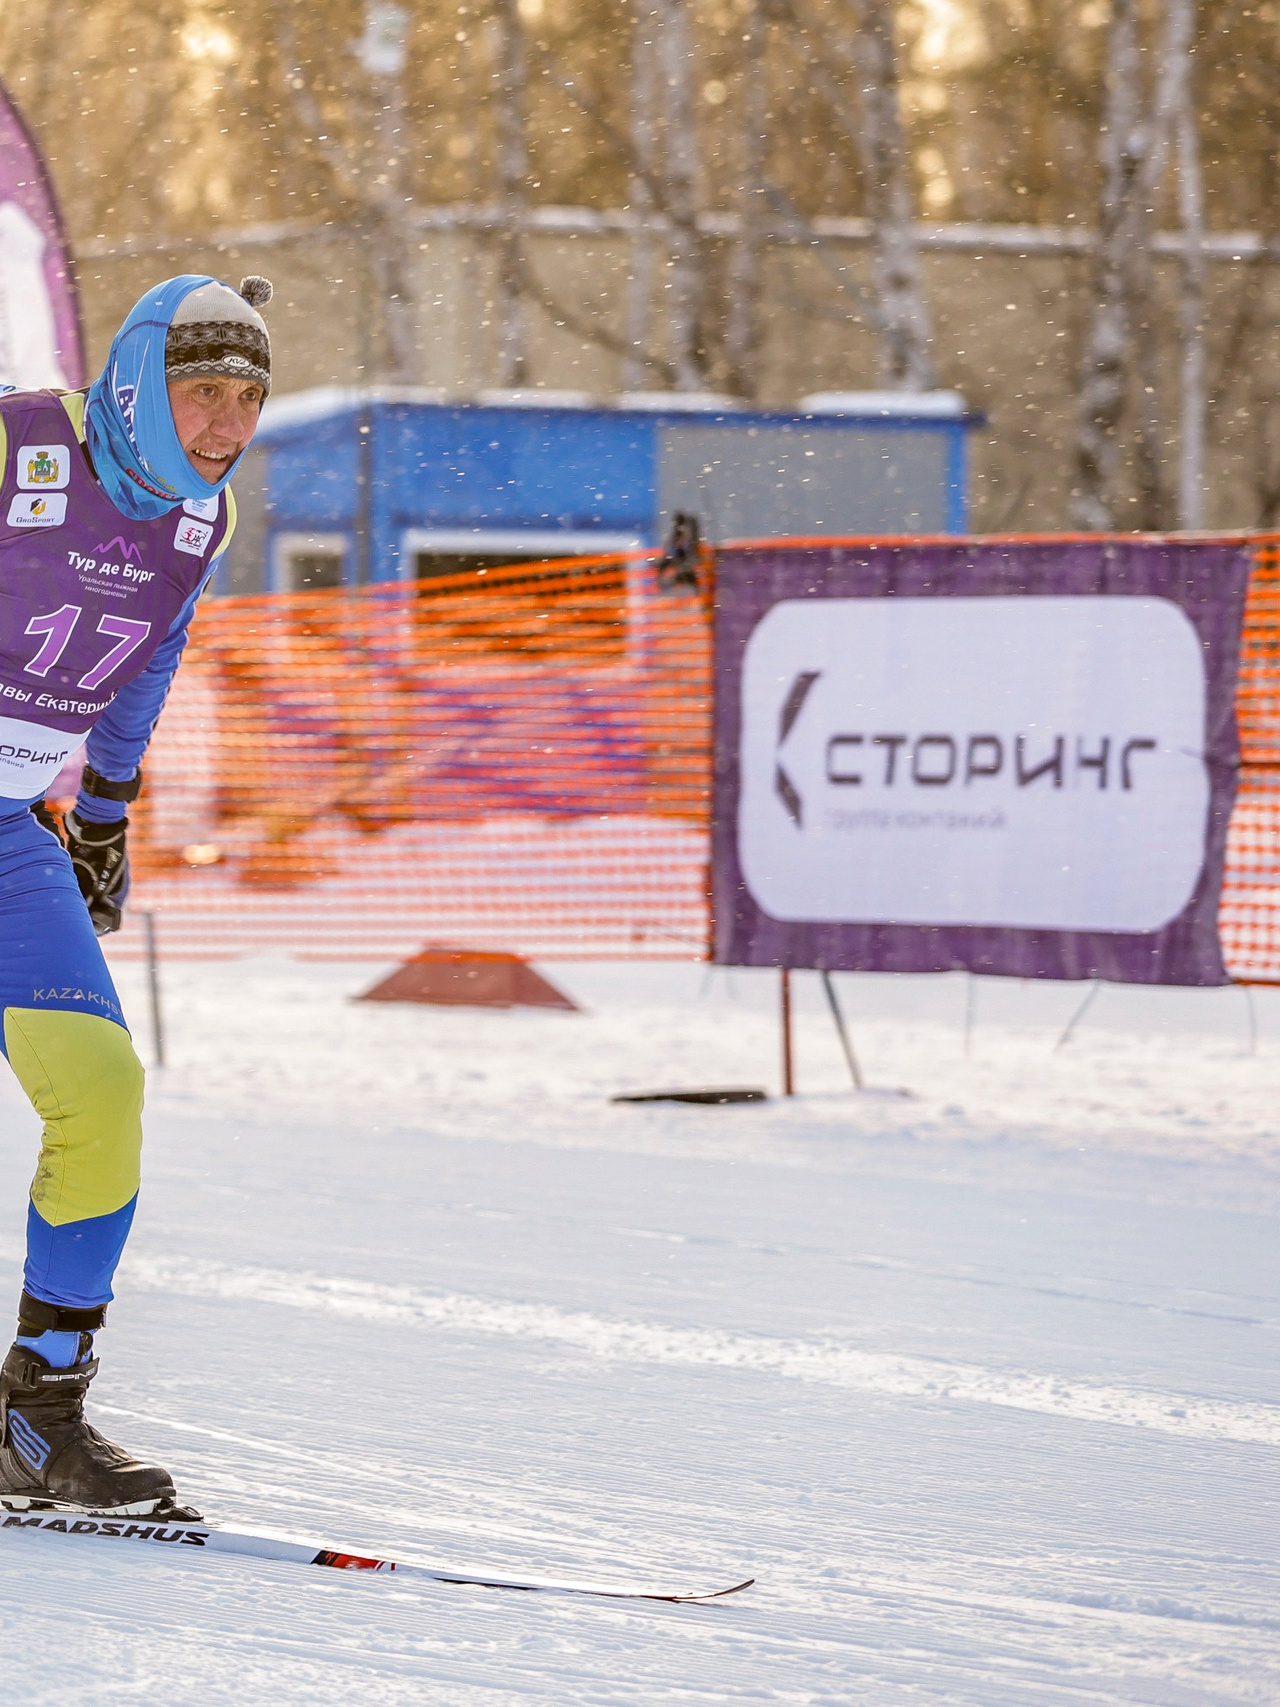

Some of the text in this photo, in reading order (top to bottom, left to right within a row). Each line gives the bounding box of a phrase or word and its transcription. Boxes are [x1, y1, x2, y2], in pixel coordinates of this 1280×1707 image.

[67, 550, 156, 584] Тур де Бург
[23, 603, 152, 691] 17
[825, 733, 1157, 791] СТОРИНГ
[33, 987, 122, 1016] KAZAKHS
[41, 1366, 97, 1382] SPINE
[1, 1516, 210, 1546] MADSHUS
